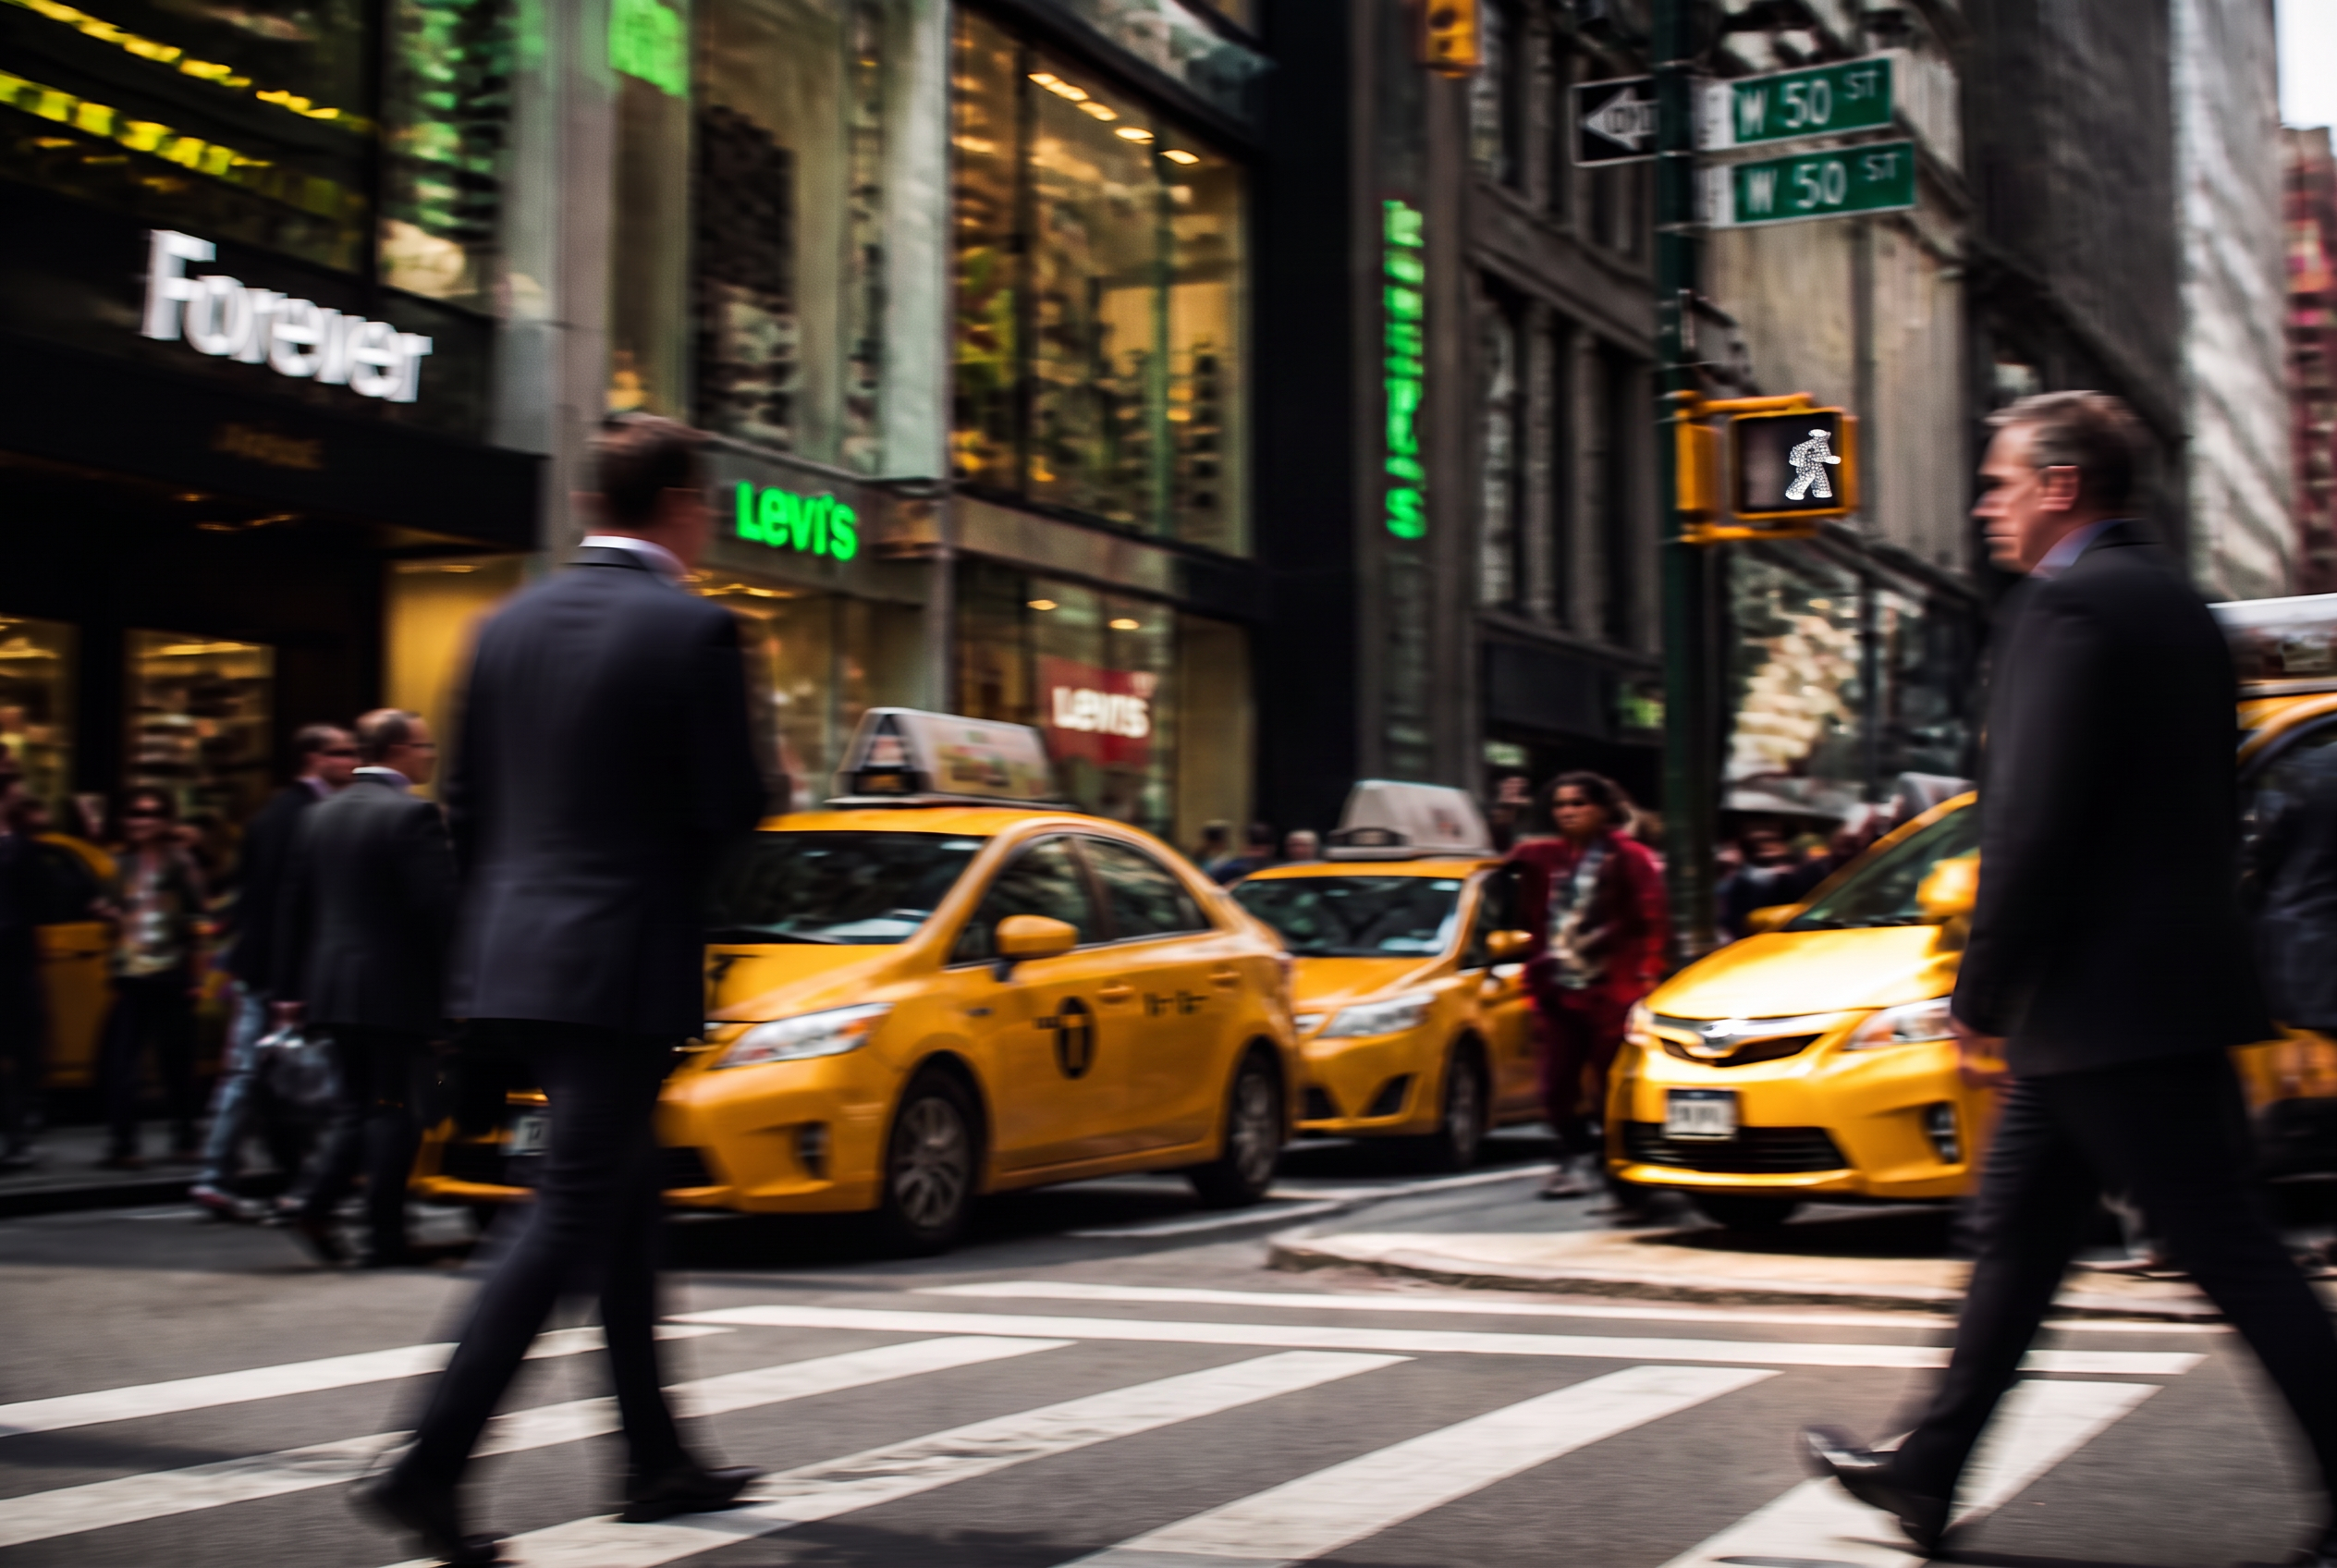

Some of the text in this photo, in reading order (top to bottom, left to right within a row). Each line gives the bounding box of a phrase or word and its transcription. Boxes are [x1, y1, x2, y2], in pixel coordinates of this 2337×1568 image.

[1731, 88, 1768, 137] W
[1780, 80, 1832, 128] 50
[1843, 70, 1878, 99] ST
[1744, 168, 1778, 214] W
[1793, 160, 1847, 209] 50
[1862, 153, 1900, 181] ST
[141, 229, 432, 403] Forever
[736, 480, 858, 562] Levi's
